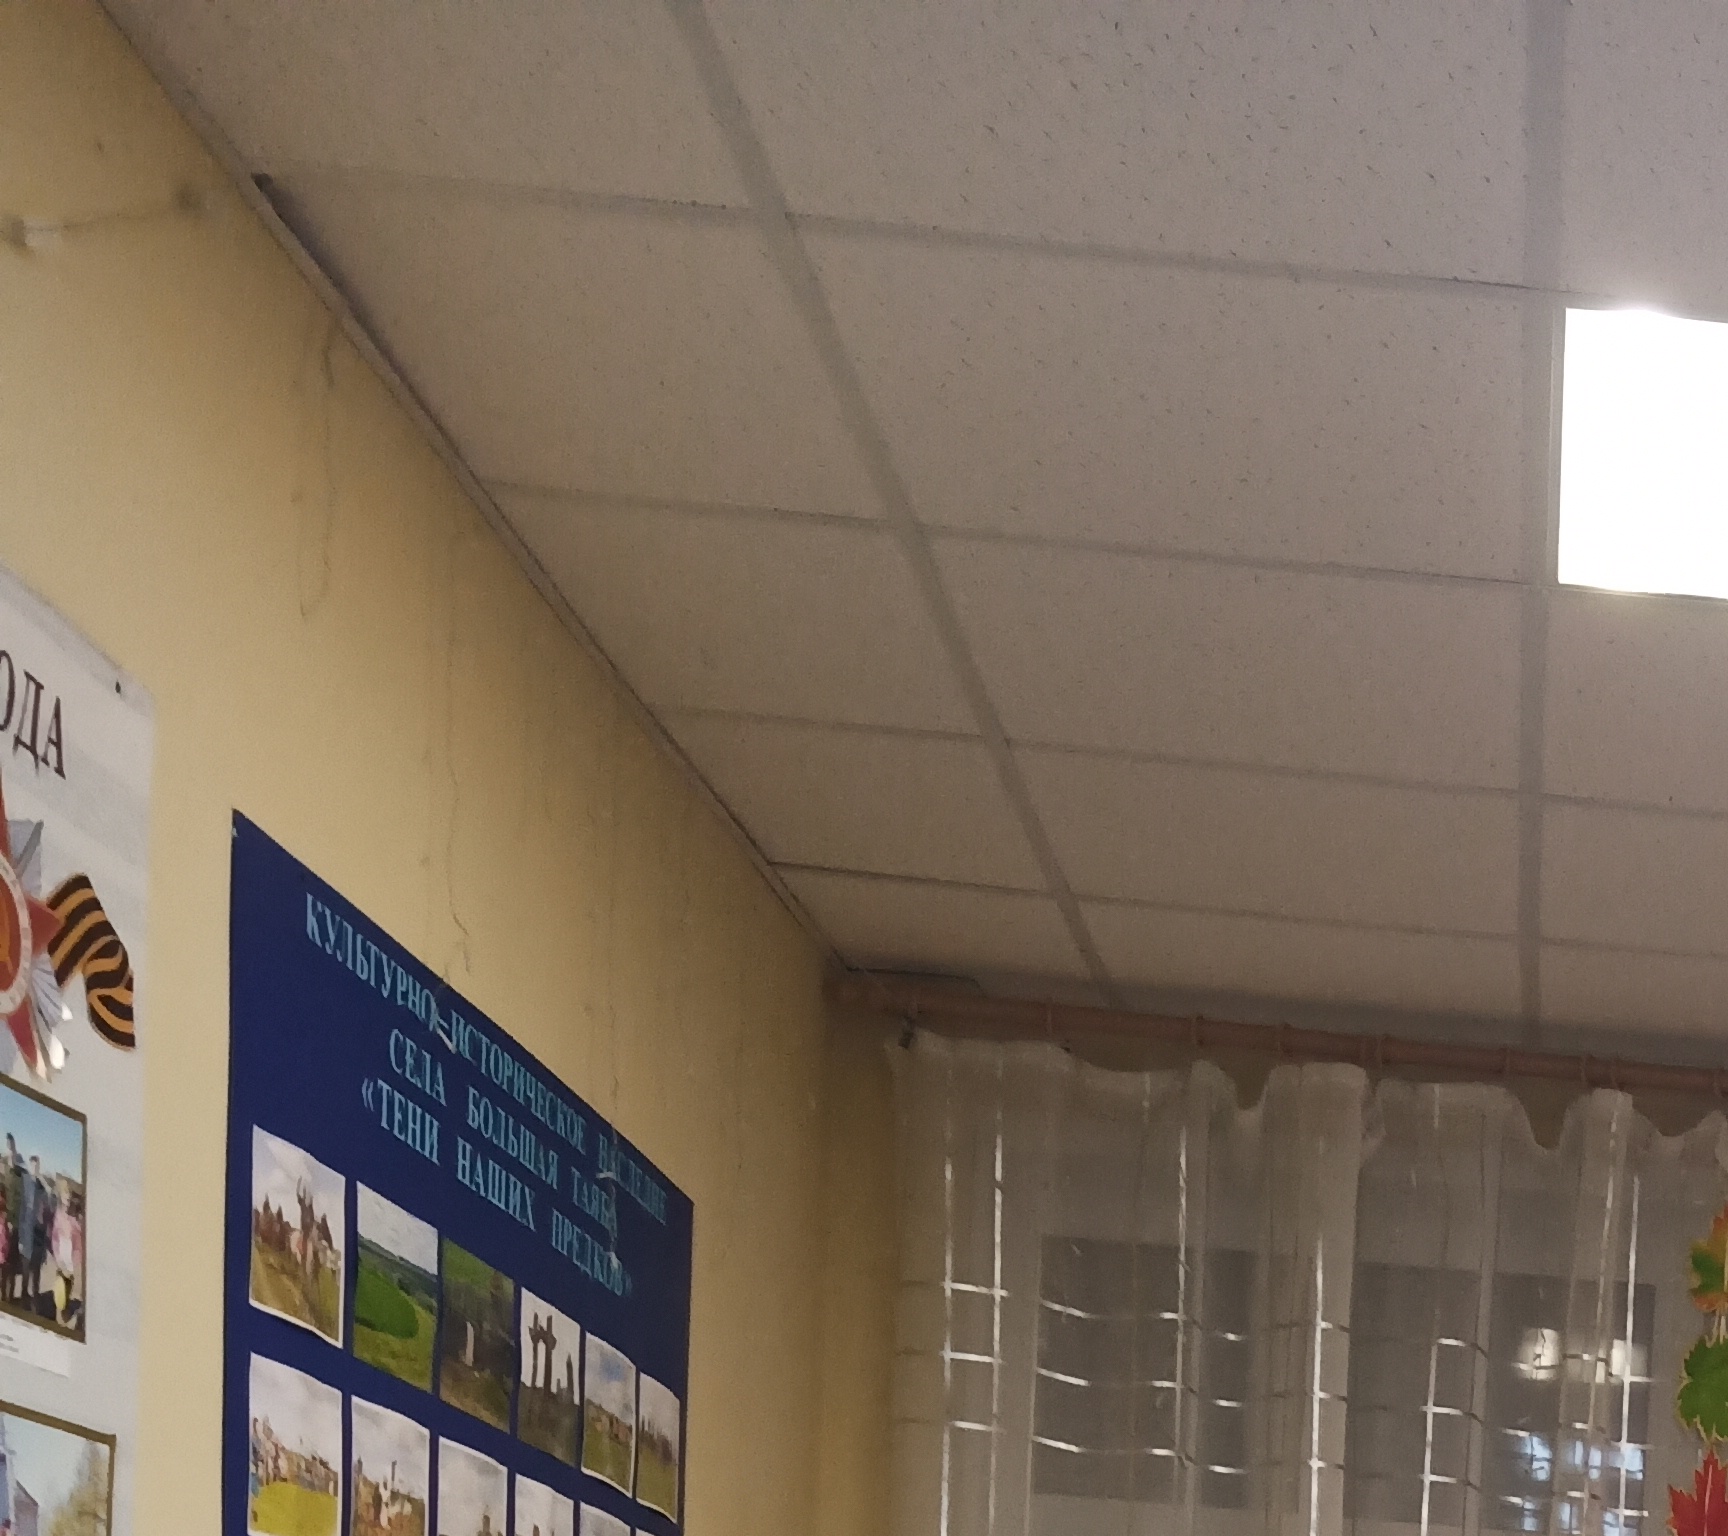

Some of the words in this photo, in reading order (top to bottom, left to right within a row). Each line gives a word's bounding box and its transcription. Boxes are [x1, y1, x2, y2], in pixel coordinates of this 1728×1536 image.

[361, 1077, 441, 1166] «ТЕНИ
[457, 1136, 536, 1232] НАШИХ
[389, 1028, 447, 1107] СЕЛА
[467, 1085, 559, 1190] БОЛЬШАЯ
